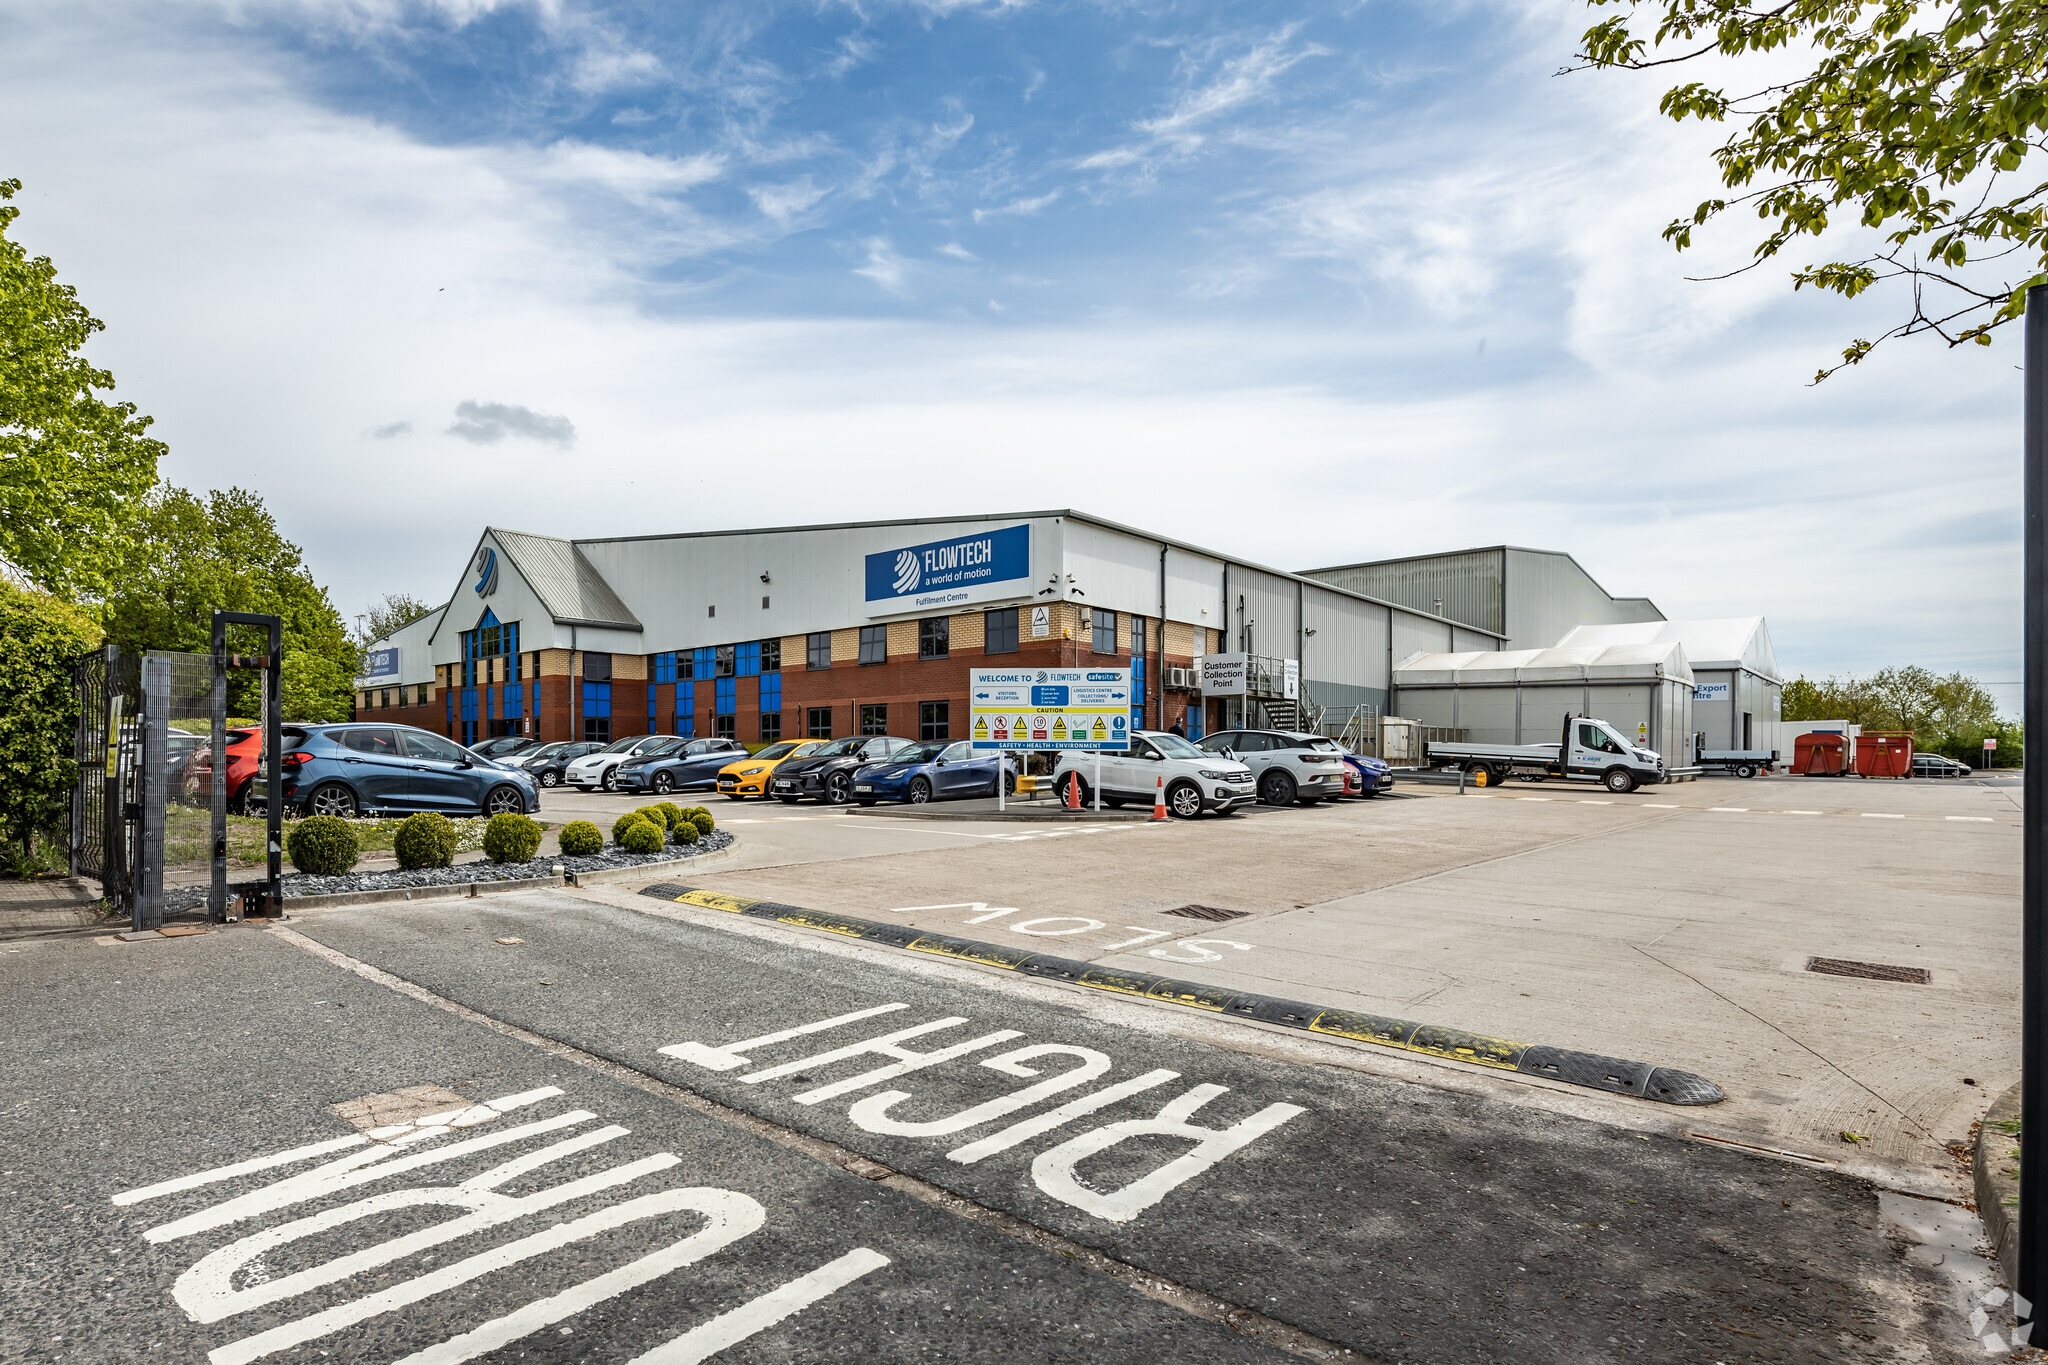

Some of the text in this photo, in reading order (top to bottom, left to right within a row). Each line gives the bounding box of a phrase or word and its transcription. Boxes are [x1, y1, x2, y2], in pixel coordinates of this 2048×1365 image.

[925, 539, 992, 573] FLOWTECH
[925, 567, 992, 586] a world of motion
[916, 593, 969, 606] Fulfilment Centre
[1204, 662, 1243, 670] Customer
[1050, 673, 1081, 681] FLOWTECH
[1204, 670, 1243, 679] Collection
[1213, 680, 1233, 688] Point
[1697, 684, 1727, 693] Export
[890, 902, 1258, 963] SLOW
[656, 1003, 1307, 1223] RIGHT
